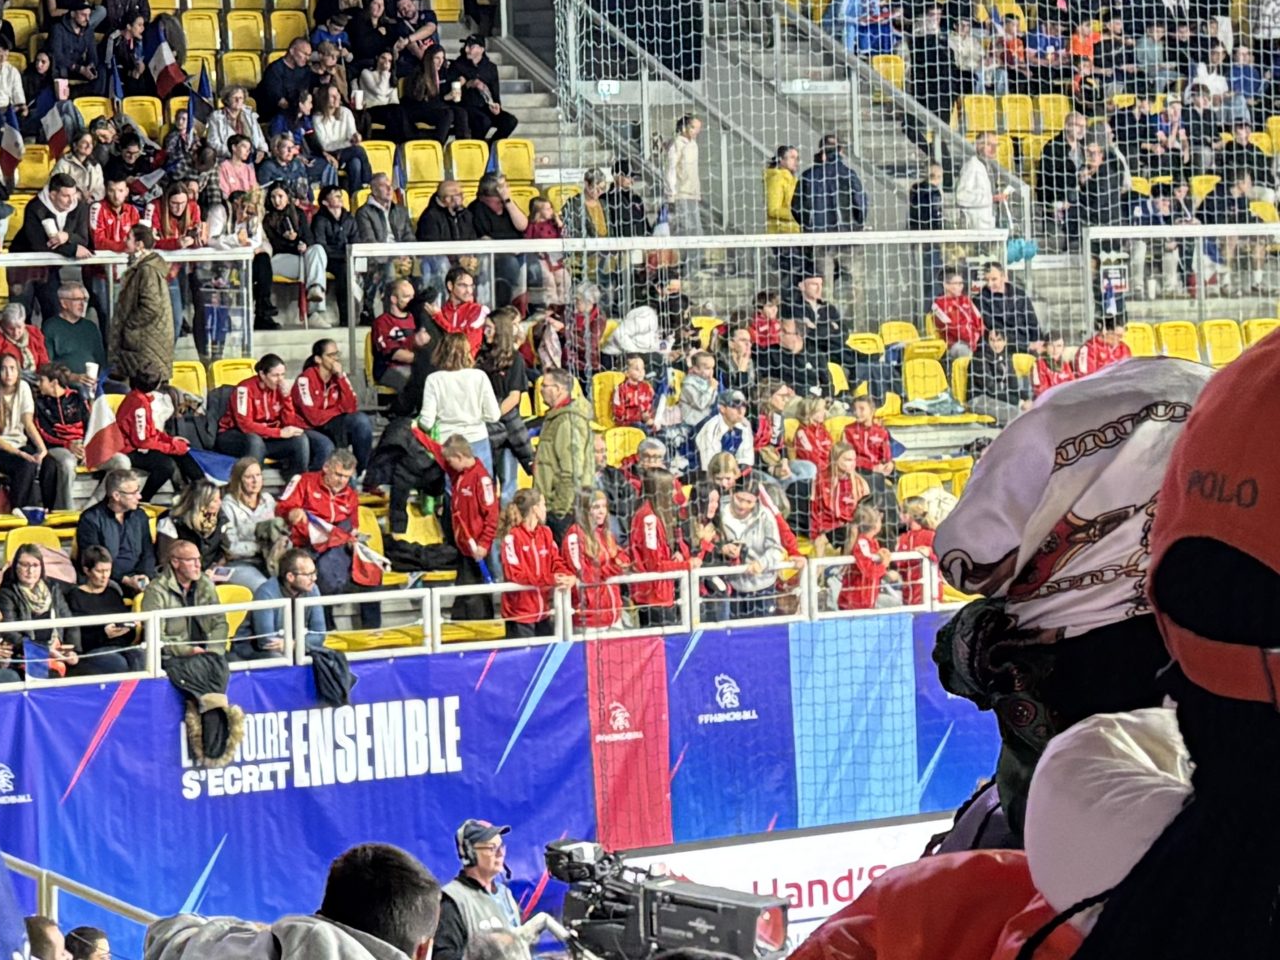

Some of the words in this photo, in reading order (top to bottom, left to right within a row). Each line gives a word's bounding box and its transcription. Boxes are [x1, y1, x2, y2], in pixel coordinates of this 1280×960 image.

[1185, 469, 1259, 508] POLO
[291, 696, 463, 788] ENSEMBLE
[181, 761, 291, 800] S'ECRIT
